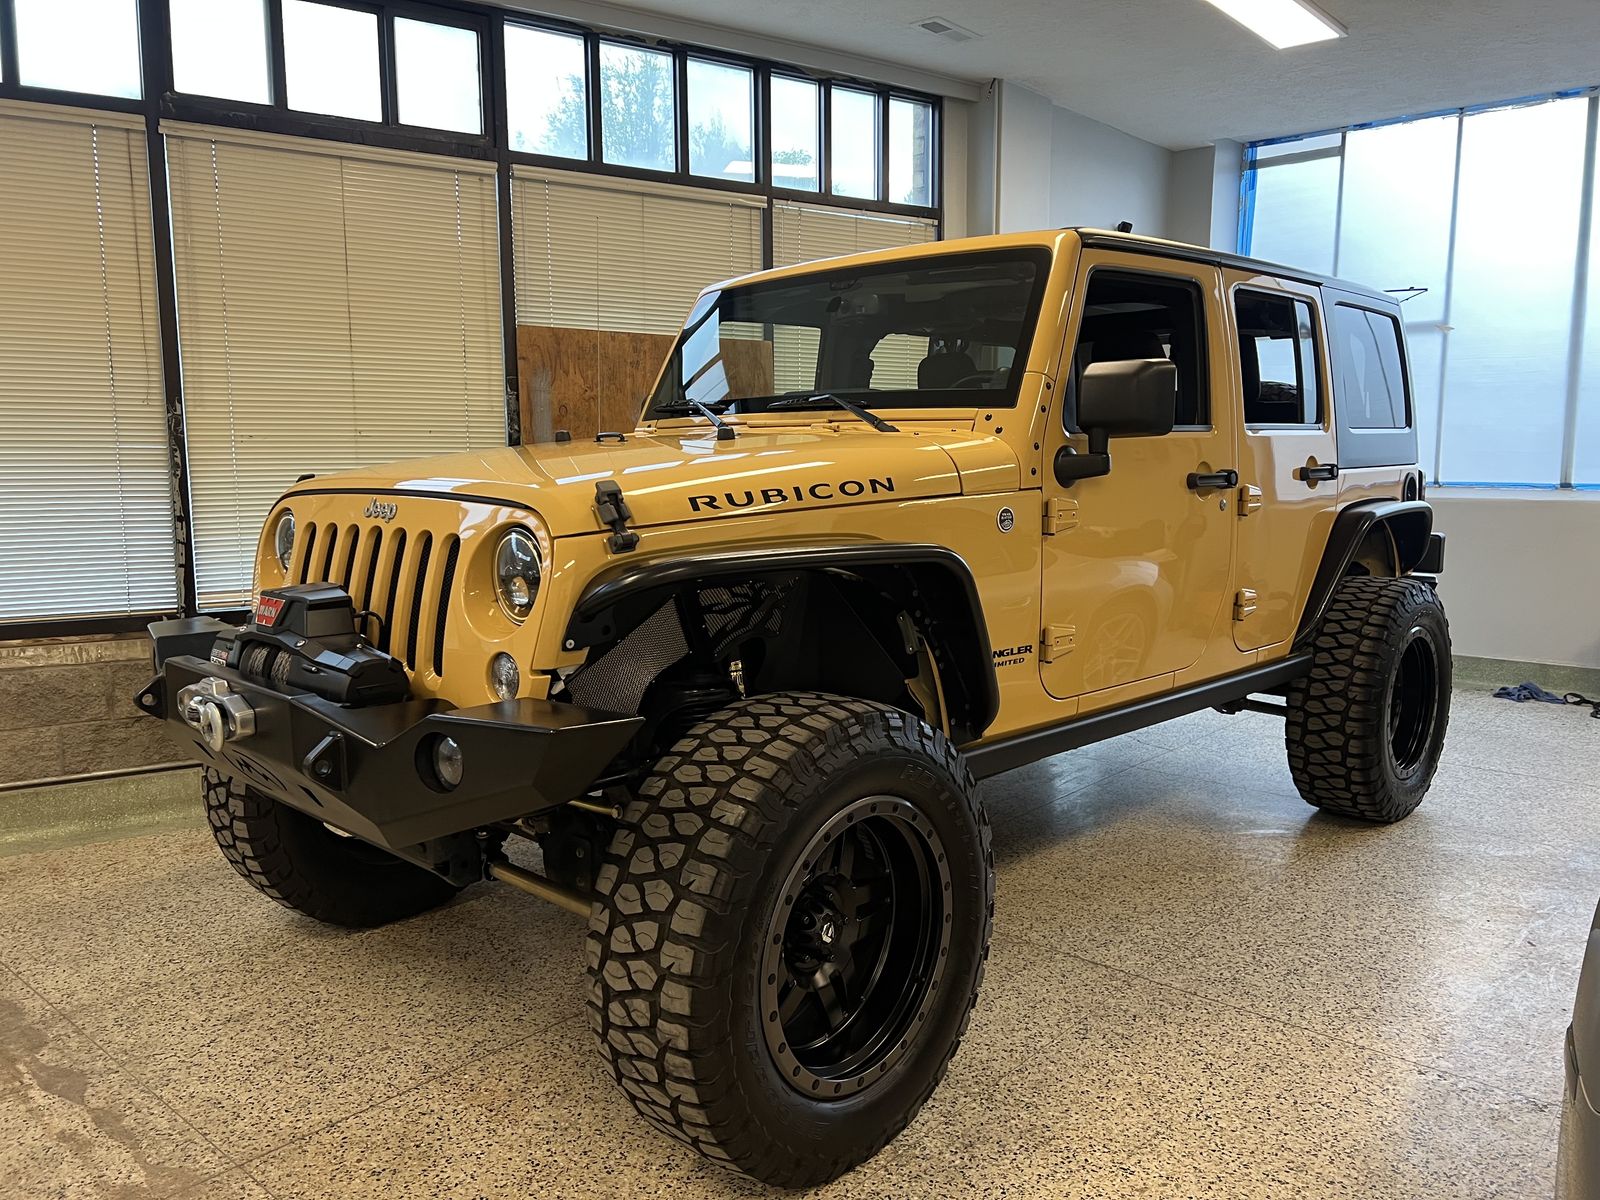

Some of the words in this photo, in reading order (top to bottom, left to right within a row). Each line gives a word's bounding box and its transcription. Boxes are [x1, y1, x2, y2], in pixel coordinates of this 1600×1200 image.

[688, 477, 895, 512] RUBICON
[364, 497, 398, 523] Jeep
[258, 605, 277, 618] WARN
[992, 645, 1033, 658] NGLER
[994, 657, 1025, 668] IMITED
